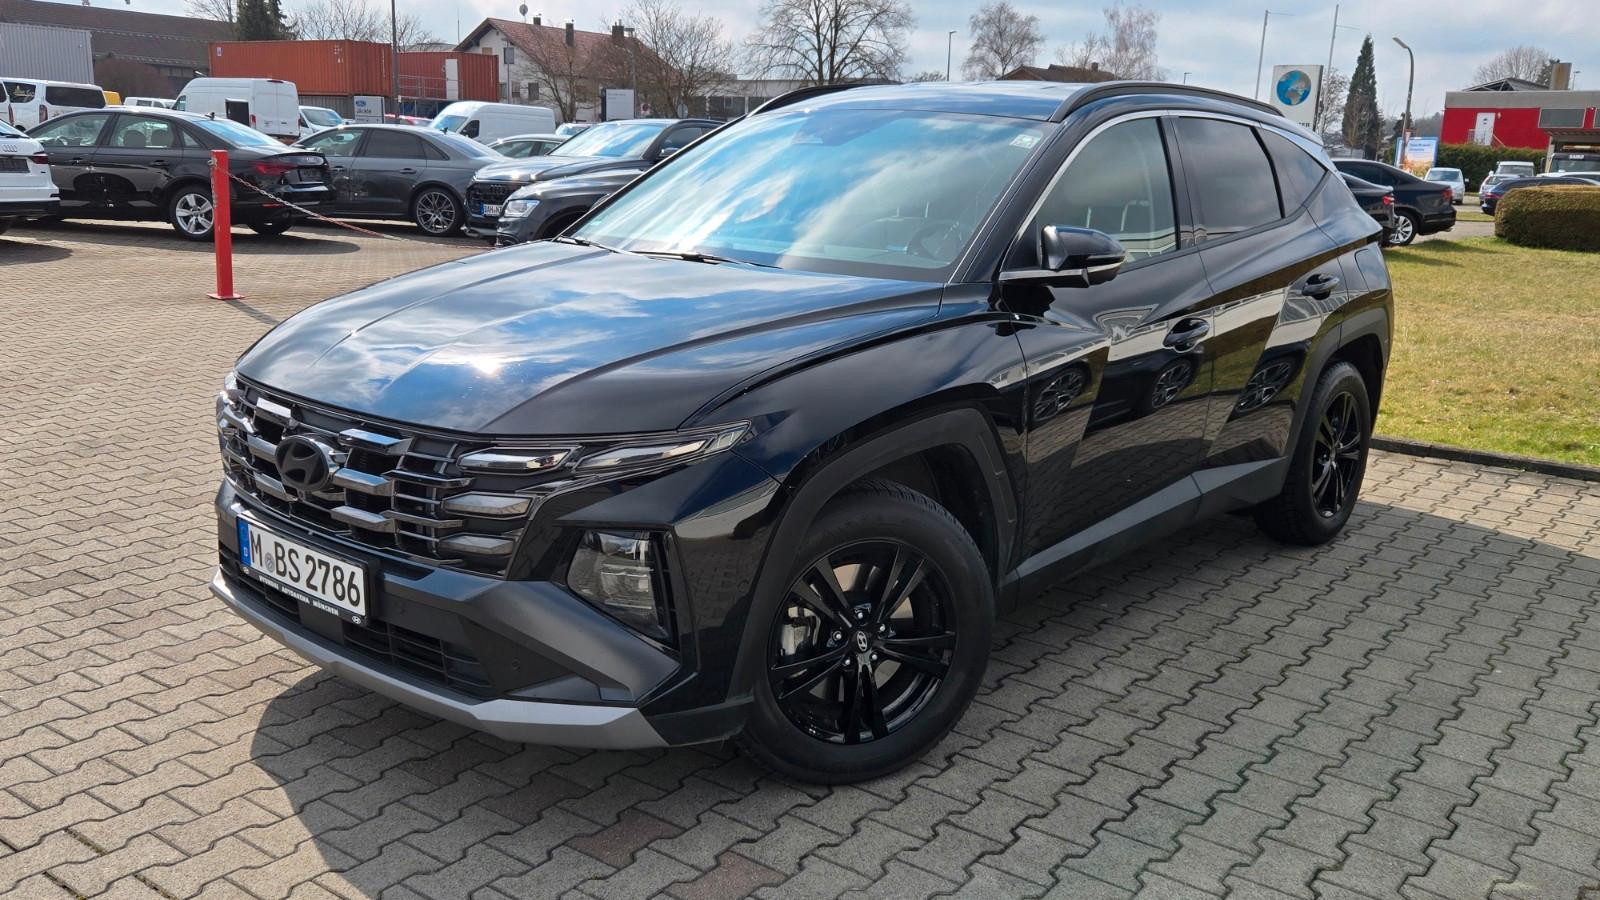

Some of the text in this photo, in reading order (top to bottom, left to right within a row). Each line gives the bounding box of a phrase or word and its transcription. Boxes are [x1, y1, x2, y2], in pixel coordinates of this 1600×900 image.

[250, 530, 361, 607] M BS 2786
[312, 599, 339, 616] MÜNCHEN
